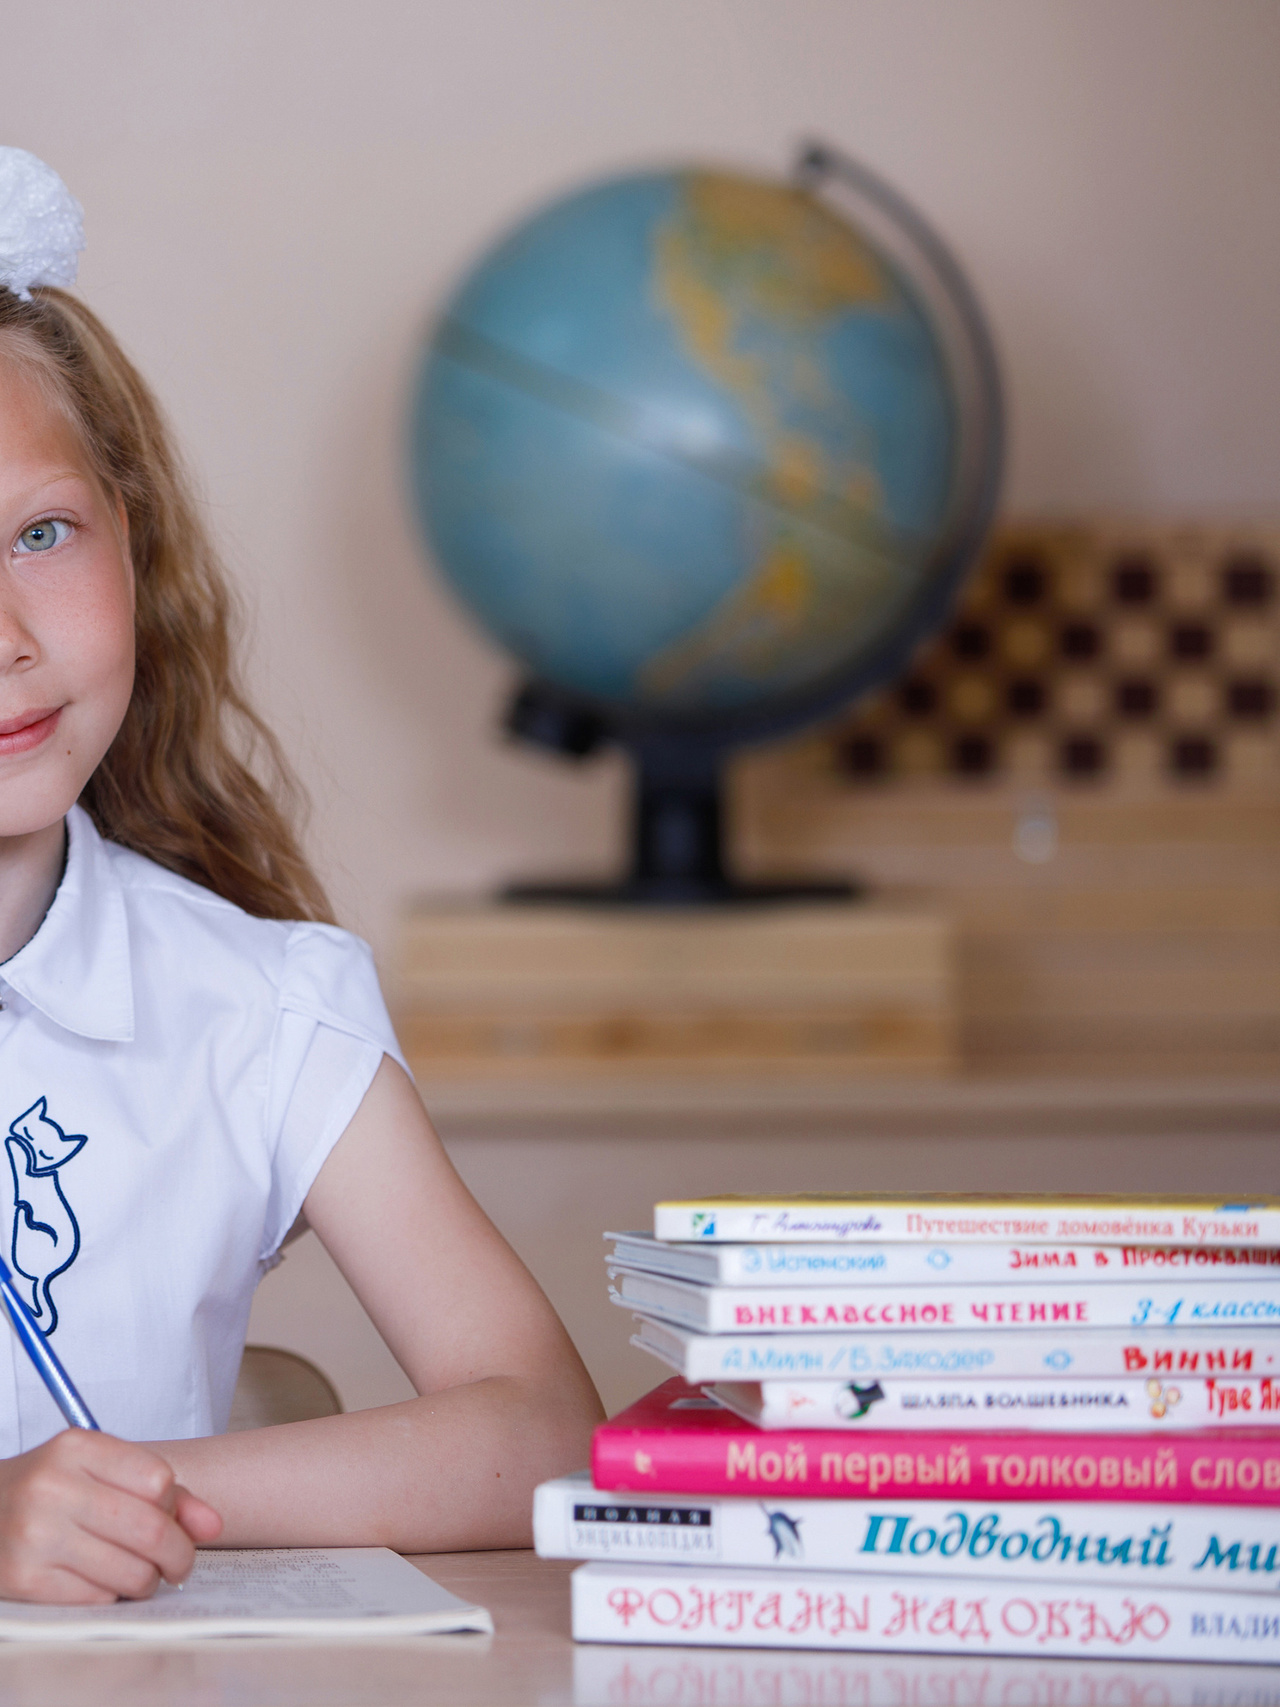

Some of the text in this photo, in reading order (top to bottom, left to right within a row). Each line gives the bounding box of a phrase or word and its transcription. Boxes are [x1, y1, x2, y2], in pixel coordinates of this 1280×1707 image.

[907, 1214, 1049, 1240] Путешествие
[1056, 1216, 1174, 1237] домовёнка
[1182, 1215, 1260, 1244] Кузьки
[734, 1303, 956, 1325] ВНЕКЛАССНОЕ
[970, 1301, 1089, 1323] ЧТЕНИЕ
[1130, 1297, 1184, 1326] 3-4
[901, 1392, 978, 1410] ШЛЯПА
[984, 1391, 1129, 1409] ВОЛШЕБНИКА
[1205, 1378, 1252, 1417] Туве
[726, 1440, 1280, 1494] Мой первый толковый слов
[582, 1506, 701, 1525] ПОЛНАЯ
[858, 1510, 1174, 1567] Подводный
[607, 1586, 869, 1637] ФОНТАНЫ
[1190, 1612, 1280, 1641] ВЛАДИ
